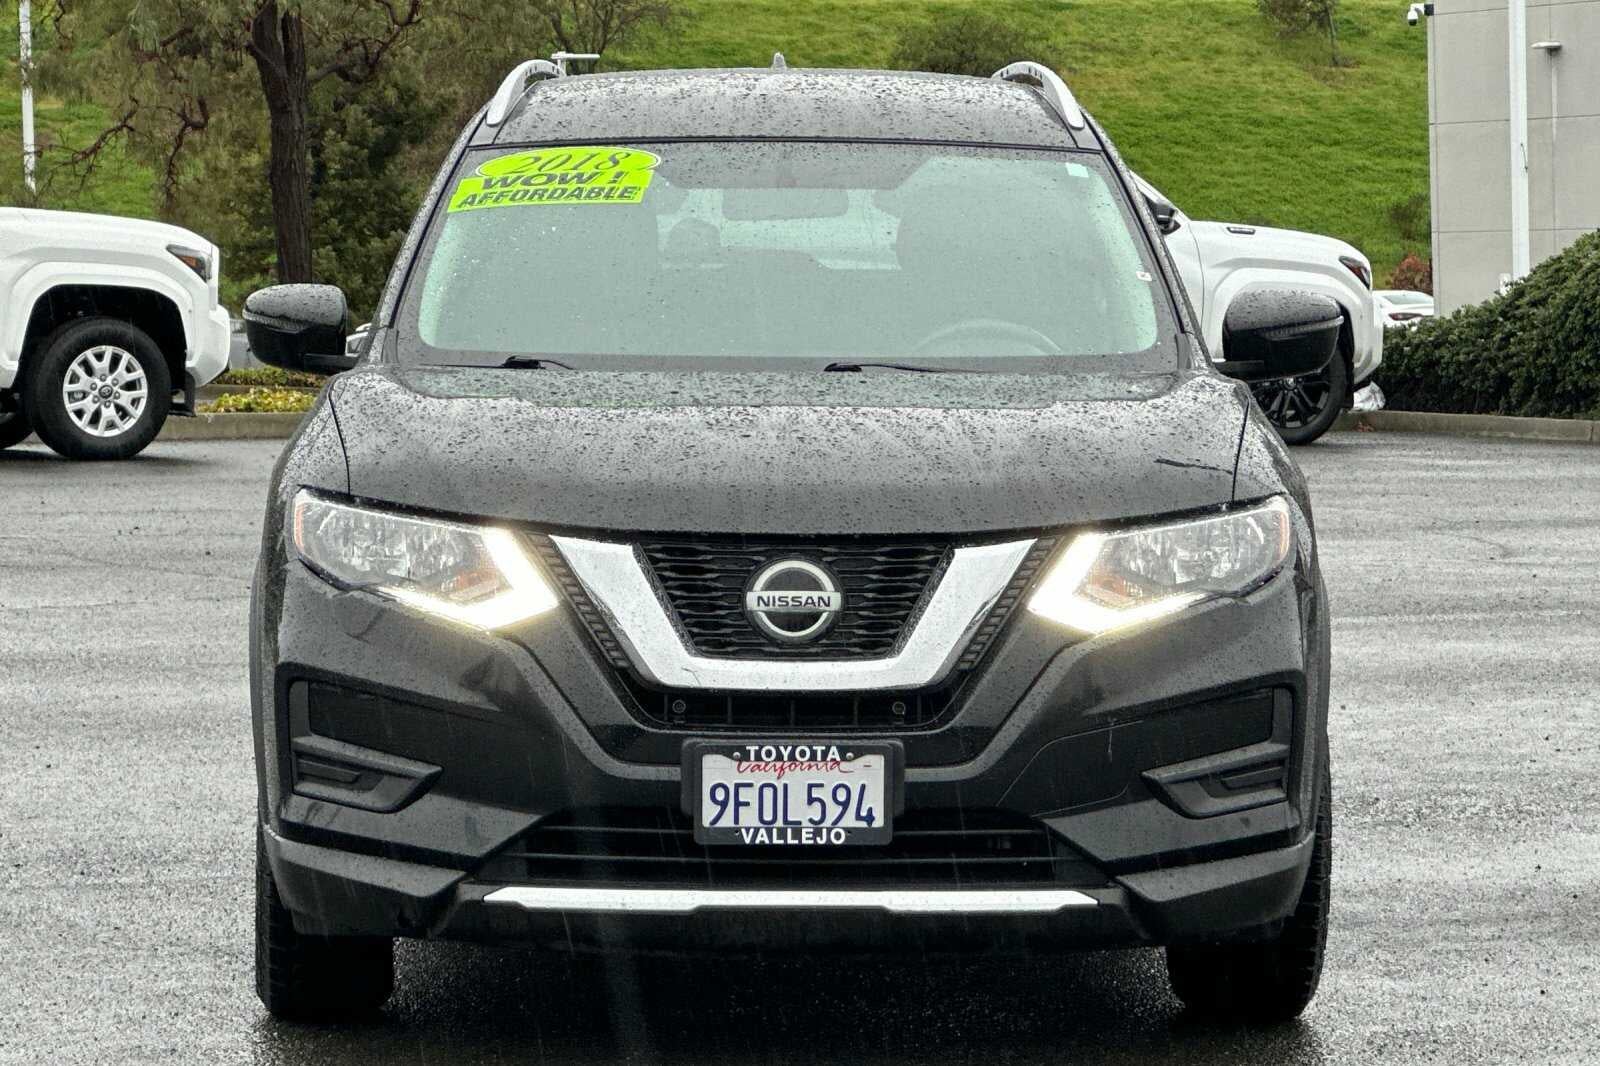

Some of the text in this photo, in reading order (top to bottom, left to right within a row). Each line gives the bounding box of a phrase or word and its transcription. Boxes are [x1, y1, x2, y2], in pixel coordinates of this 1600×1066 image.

[504, 152, 631, 174] 2018
[458, 186, 638, 208] AFFORDABLE
[757, 596, 831, 607] NISSAN
[745, 745, 842, 762] TOYOTA
[741, 828, 846, 845] VALLEJO
